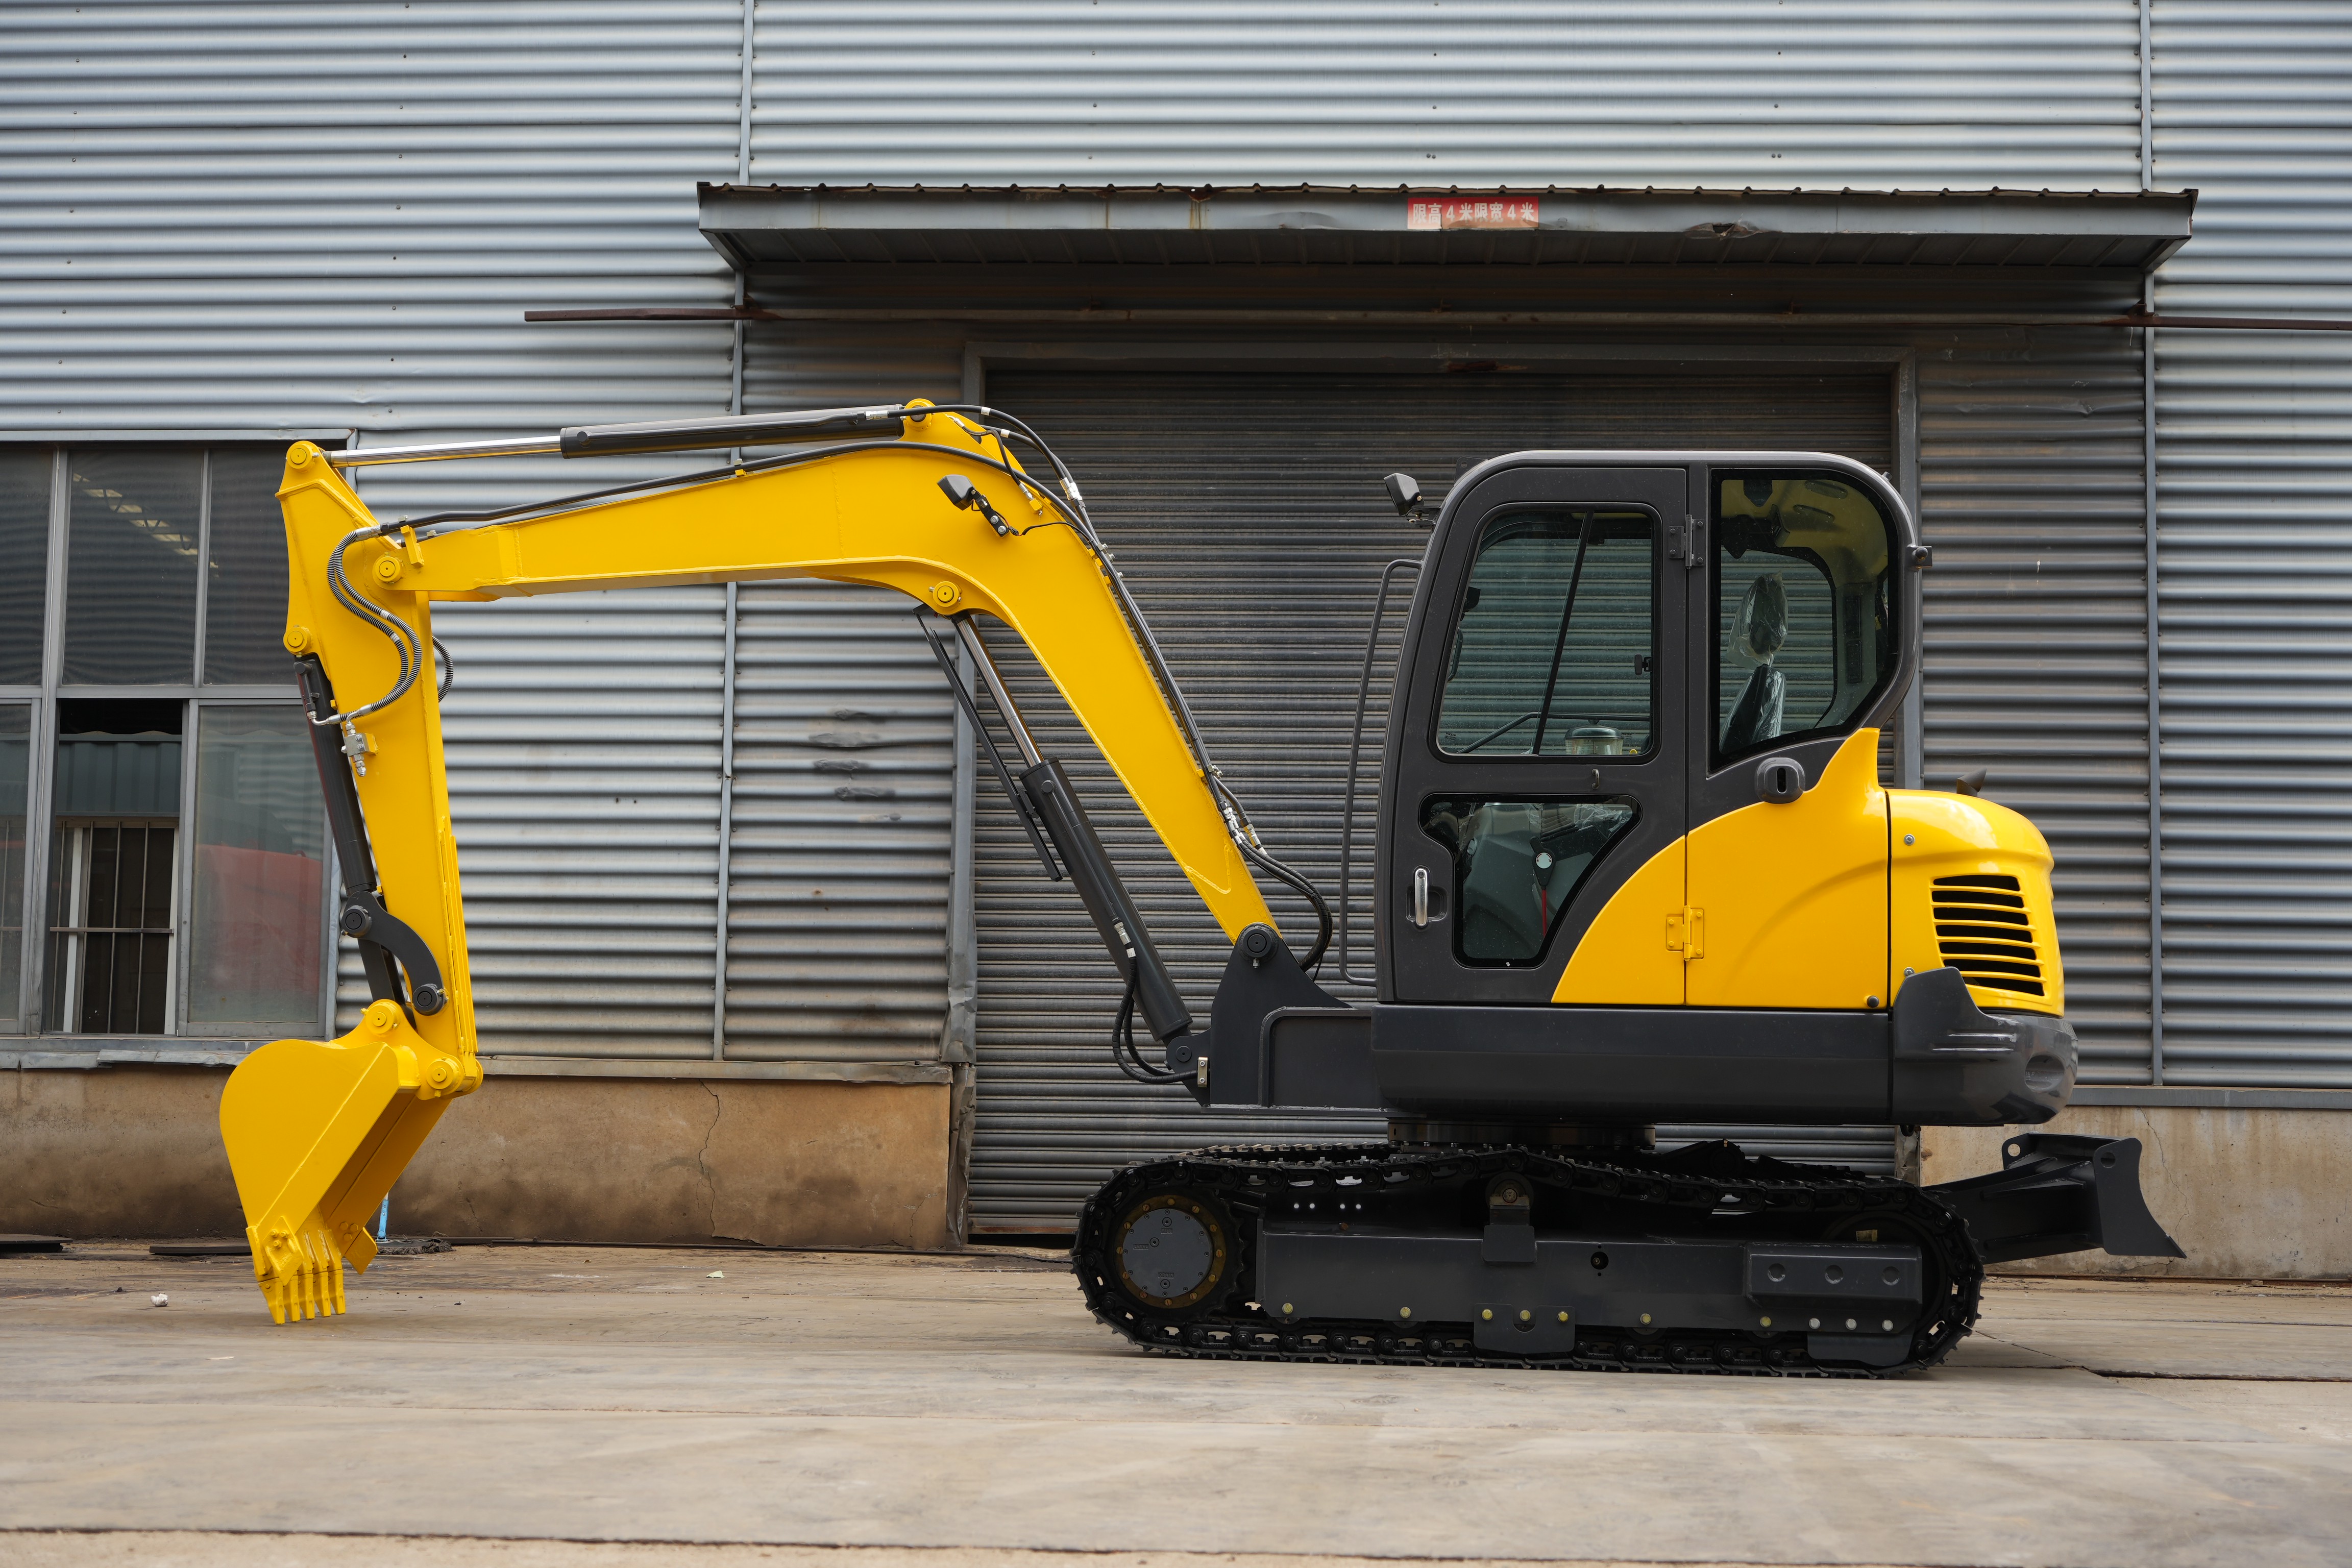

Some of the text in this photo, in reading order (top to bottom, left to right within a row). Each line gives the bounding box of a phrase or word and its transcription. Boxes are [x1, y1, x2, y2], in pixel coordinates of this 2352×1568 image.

[1413, 202, 1534, 224] 限高4米限宽4米
